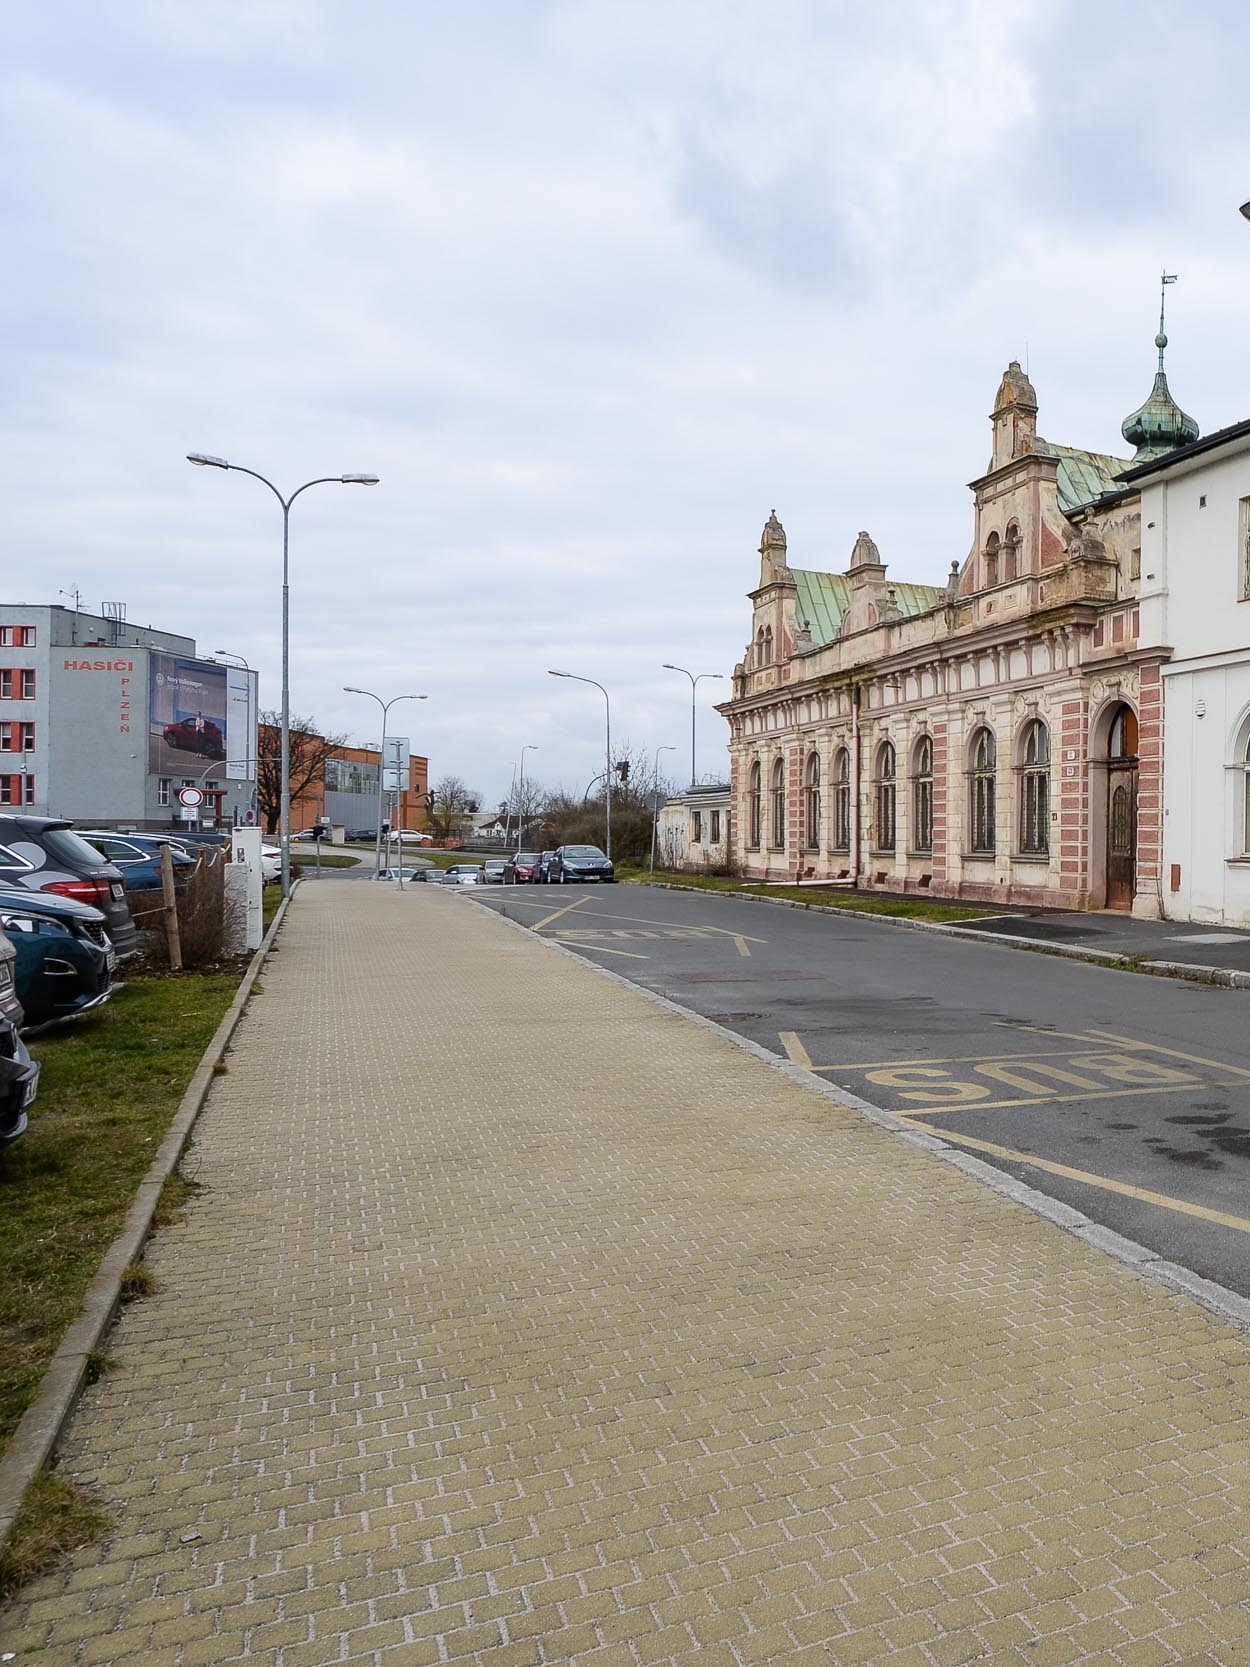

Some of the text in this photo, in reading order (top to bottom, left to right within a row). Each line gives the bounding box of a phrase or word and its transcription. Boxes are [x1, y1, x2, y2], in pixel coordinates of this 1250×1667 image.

[64, 660, 133, 671] HASIČI
[120, 678, 130, 733] PLZEŇ
[864, 1053, 1203, 1102] BUS
